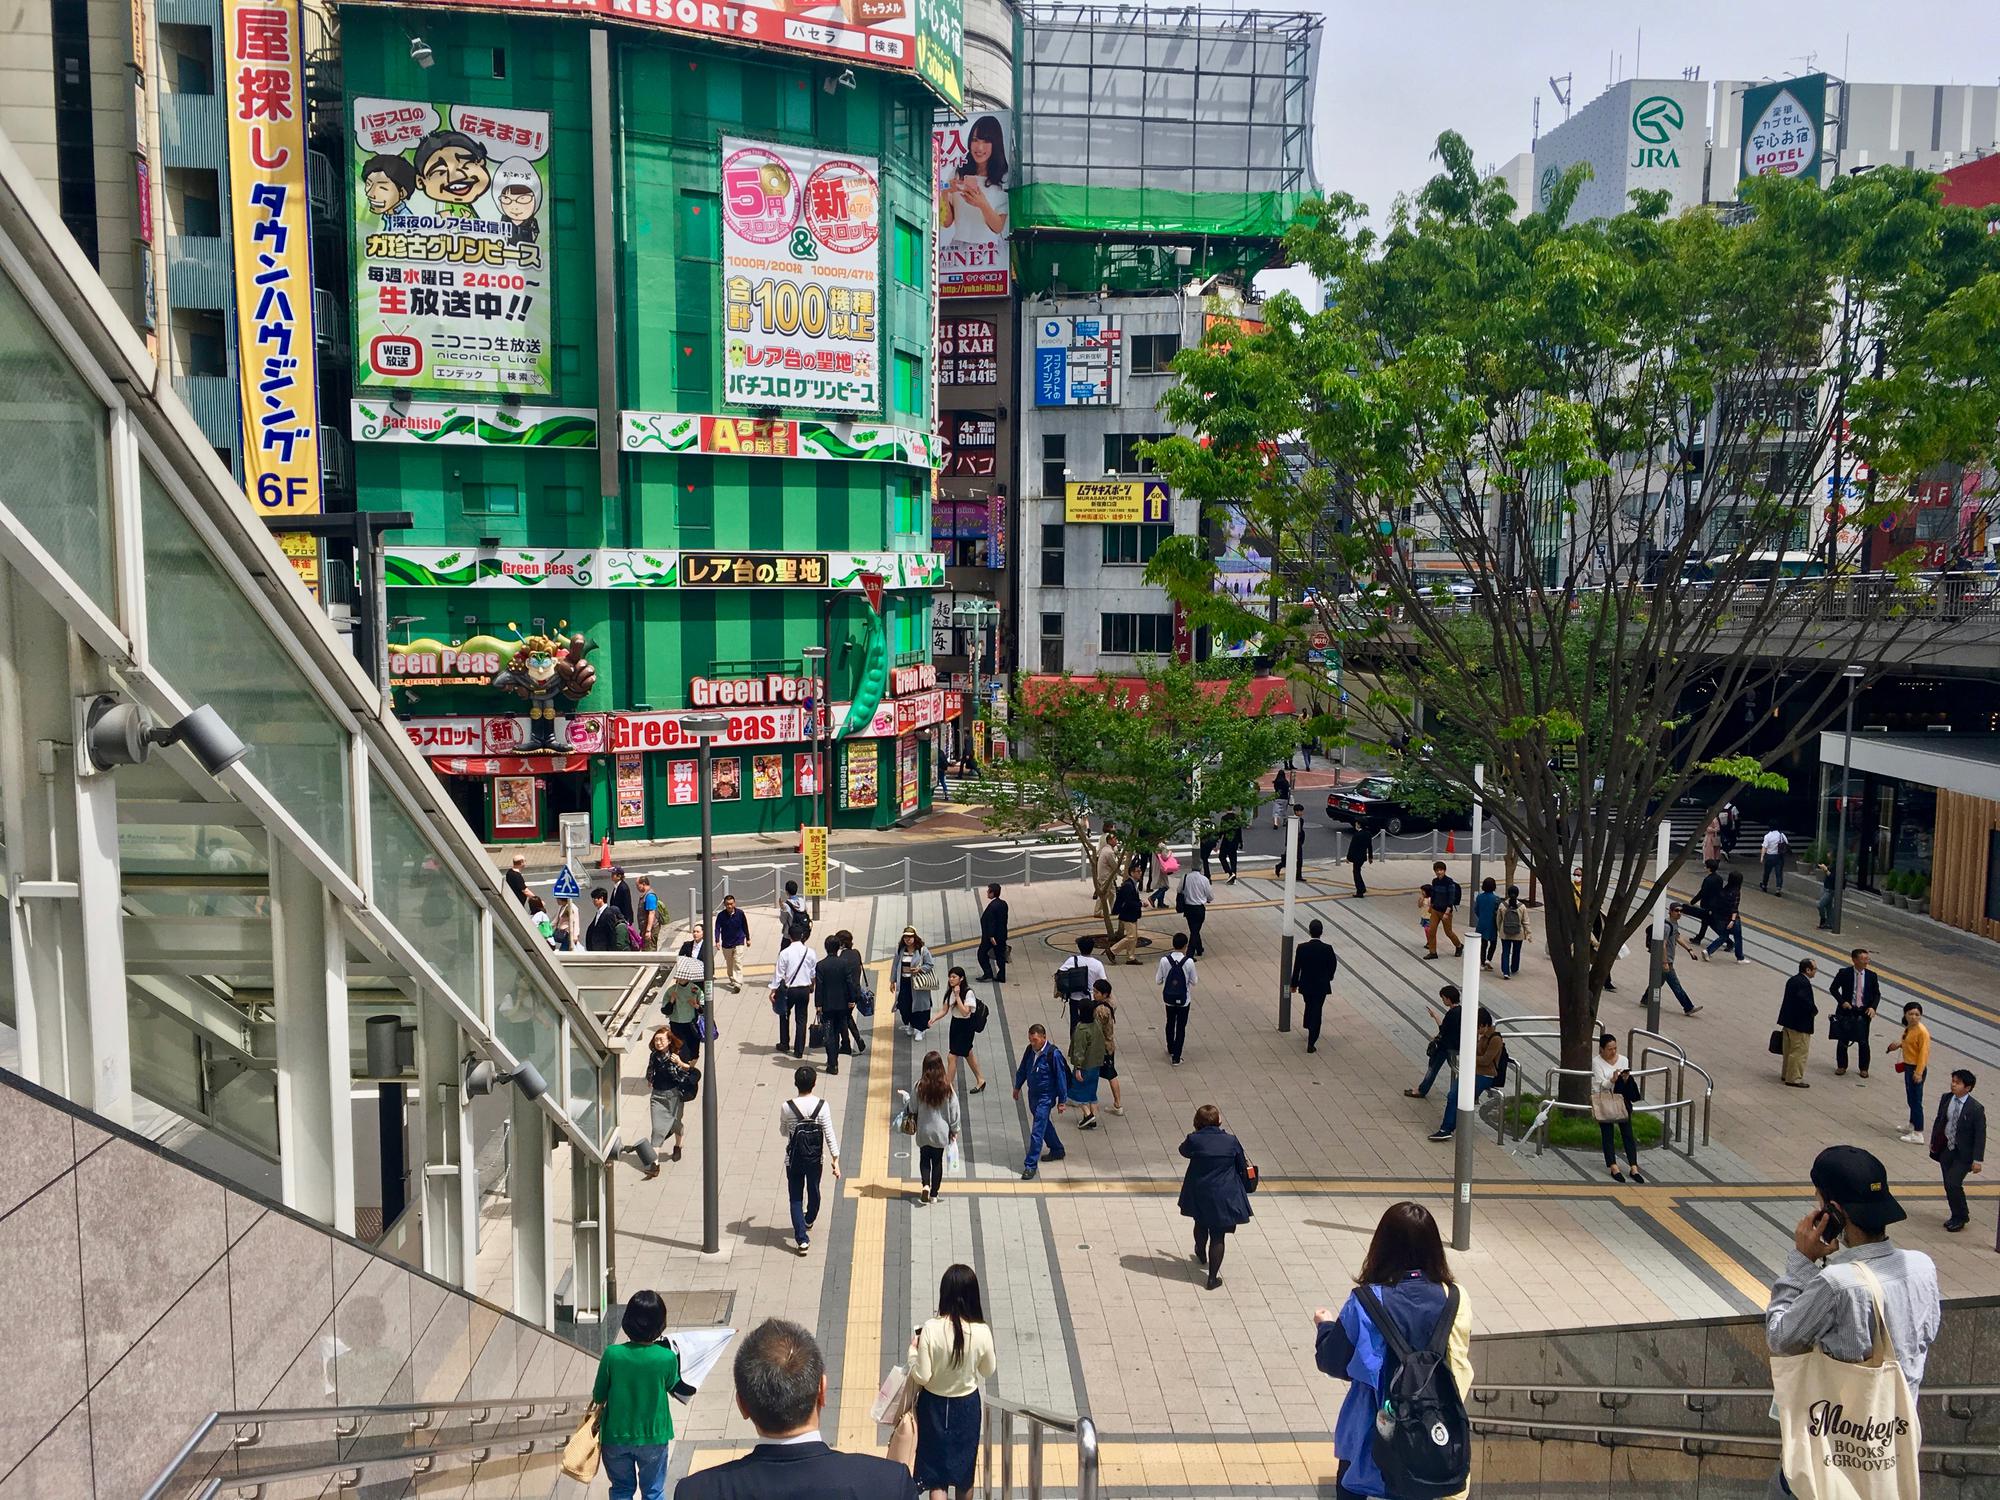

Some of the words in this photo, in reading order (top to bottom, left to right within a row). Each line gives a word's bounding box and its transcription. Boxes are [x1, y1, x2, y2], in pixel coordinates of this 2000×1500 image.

[613, 0, 758, 34] RESORTS
[862, 3, 901, 14] キャラメル
[792, 25, 836, 44] パセラ
[874, 40, 898, 54] 検索
[361, 108, 424, 130] パチスロの
[1763, 115, 1802, 129] カプセル
[370, 126, 422, 145] 楽しさを
[459, 113, 543, 150] 伝えます!
[1753, 127, 1809, 151] 安心お宿
[1631, 148, 1681, 168] JRA
[1756, 148, 1804, 165] HOTEL
[724, 169, 787, 218] 5円
[810, 176, 849, 222] 新
[392, 216, 512, 236] 深夜のレア台配信!!
[739, 218, 790, 234] スロット
[819, 221, 878, 241] スロット
[367, 234, 542, 268] ガ珍古グリンピース
[789, 227, 818, 260] &
[367, 266, 455, 287] 毎週水曜日
[379, 286, 533, 322] 生放送中!!
[754, 278, 829, 338] 100
[251, 183, 310, 463] タウンハウジング
[958, 323, 991, 337] SHA
[383, 345, 411, 356] WEB
[431, 334, 541, 354] ニコニコ生放送
[959, 339, 993, 353] KAH
[386, 356, 408, 367] 放送
[437, 352, 500, 362] niconico
[745, 345, 853, 372] レア台の聖地
[436, 369, 483, 379] エンデック
[507, 373, 528, 382] 検索
[1043, 354, 1053, 399] アイシティ
[729, 375, 790, 398] パチスロ
[794, 377, 875, 404] グリンピース
[382, 415, 442, 430] Pachislo
[960, 421, 975, 433] 4F
[257, 473, 309, 507] 6F
[1077, 485, 1131, 496] ムラサキスポーツ
[502, 561, 541, 575] Green
[544, 562, 574, 576] Peas
[689, 558, 821, 583] レア台の聖地
[442, 650, 500, 674] Peas
[692, 678, 764, 705] Green
[766, 675, 823, 701] Peas
[896, 669, 919, 695] Green
[919, 665, 936, 688] Peas
[491, 721, 513, 742] 新
[709, 714, 775, 742] eas
[674, 762, 693, 802] 新台
[840, 766, 848, 788] Green
[840, 789, 848, 808] Peas
[1809, 1400, 1909, 1447] Monkey's
[1834, 1440, 1885, 1459] BOOKS
